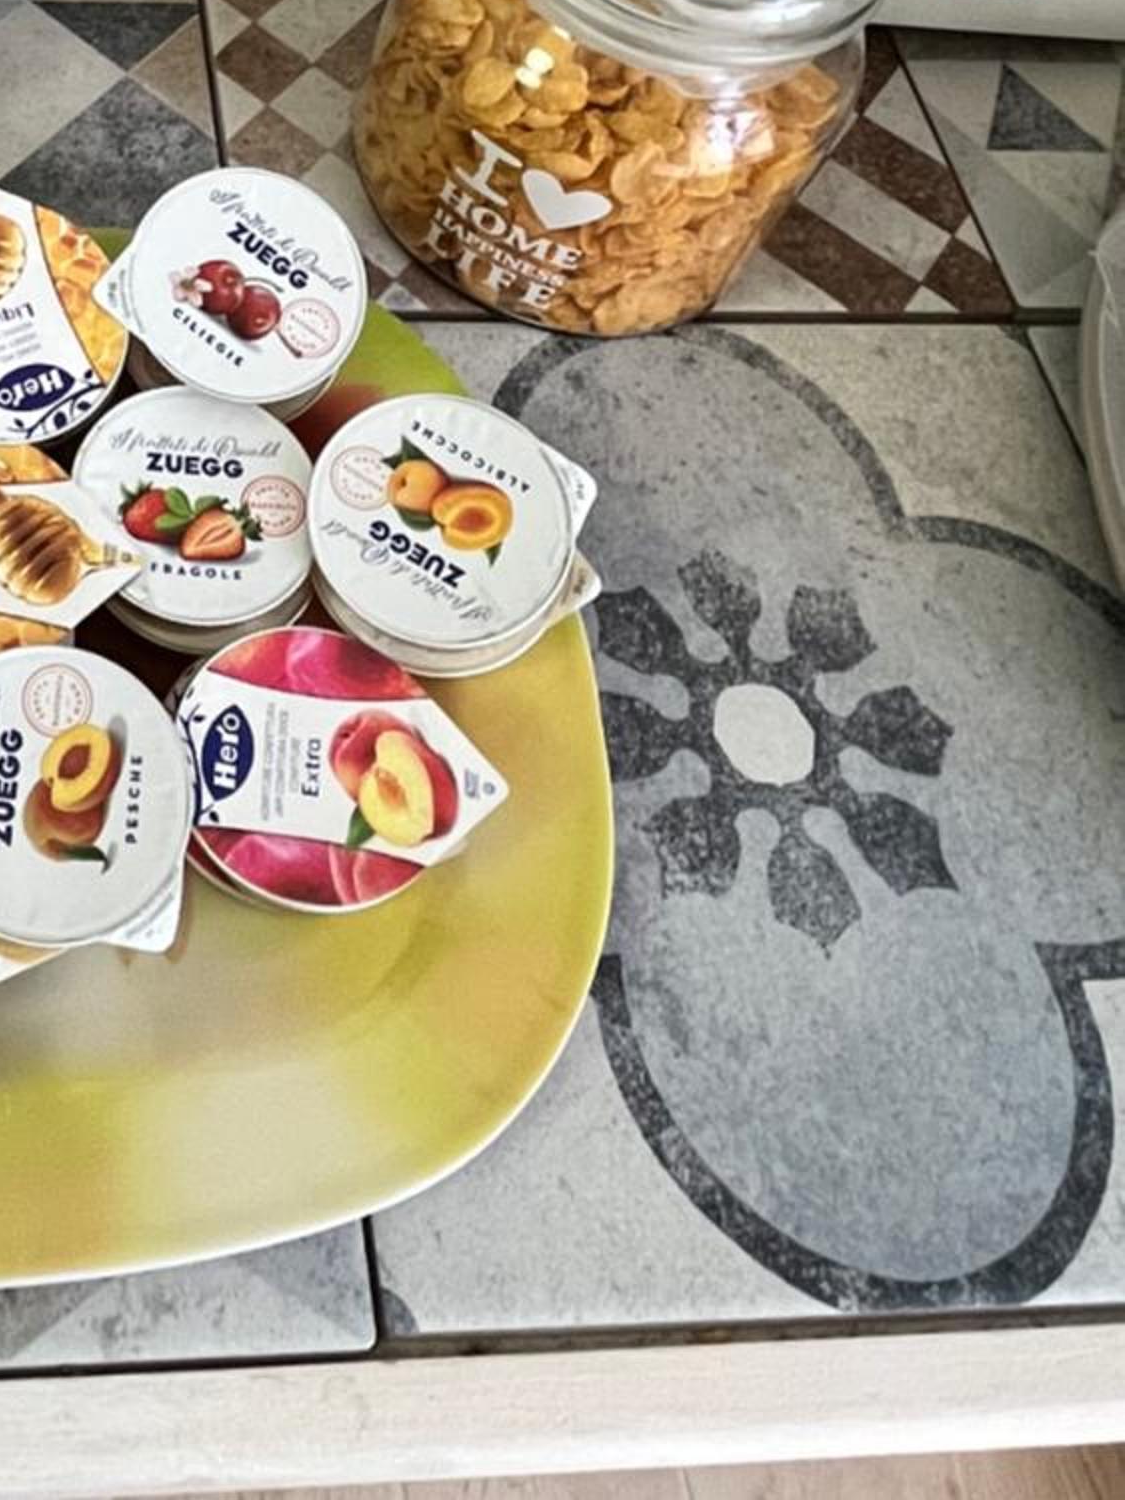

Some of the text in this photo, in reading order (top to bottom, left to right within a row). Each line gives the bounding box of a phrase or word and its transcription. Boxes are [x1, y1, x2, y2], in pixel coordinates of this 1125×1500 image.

[453, 128, 524, 207] I
[227, 221, 310, 290] ZUEGG
[439, 177, 584, 271] HOME
[427, 220, 558, 311] LIFE
[172, 307, 245, 368] CILIEGIE
[145, 452, 244, 479] ZUEGG
[411, 420, 531, 493] ALBICOCCHE
[150, 562, 243, 581] FRAGOLE
[368, 519, 467, 589] ZUEGG
[213, 712, 241, 790] Hero
[302, 739, 322, 797] Extra
[125, 755, 144, 845] PESCHE
